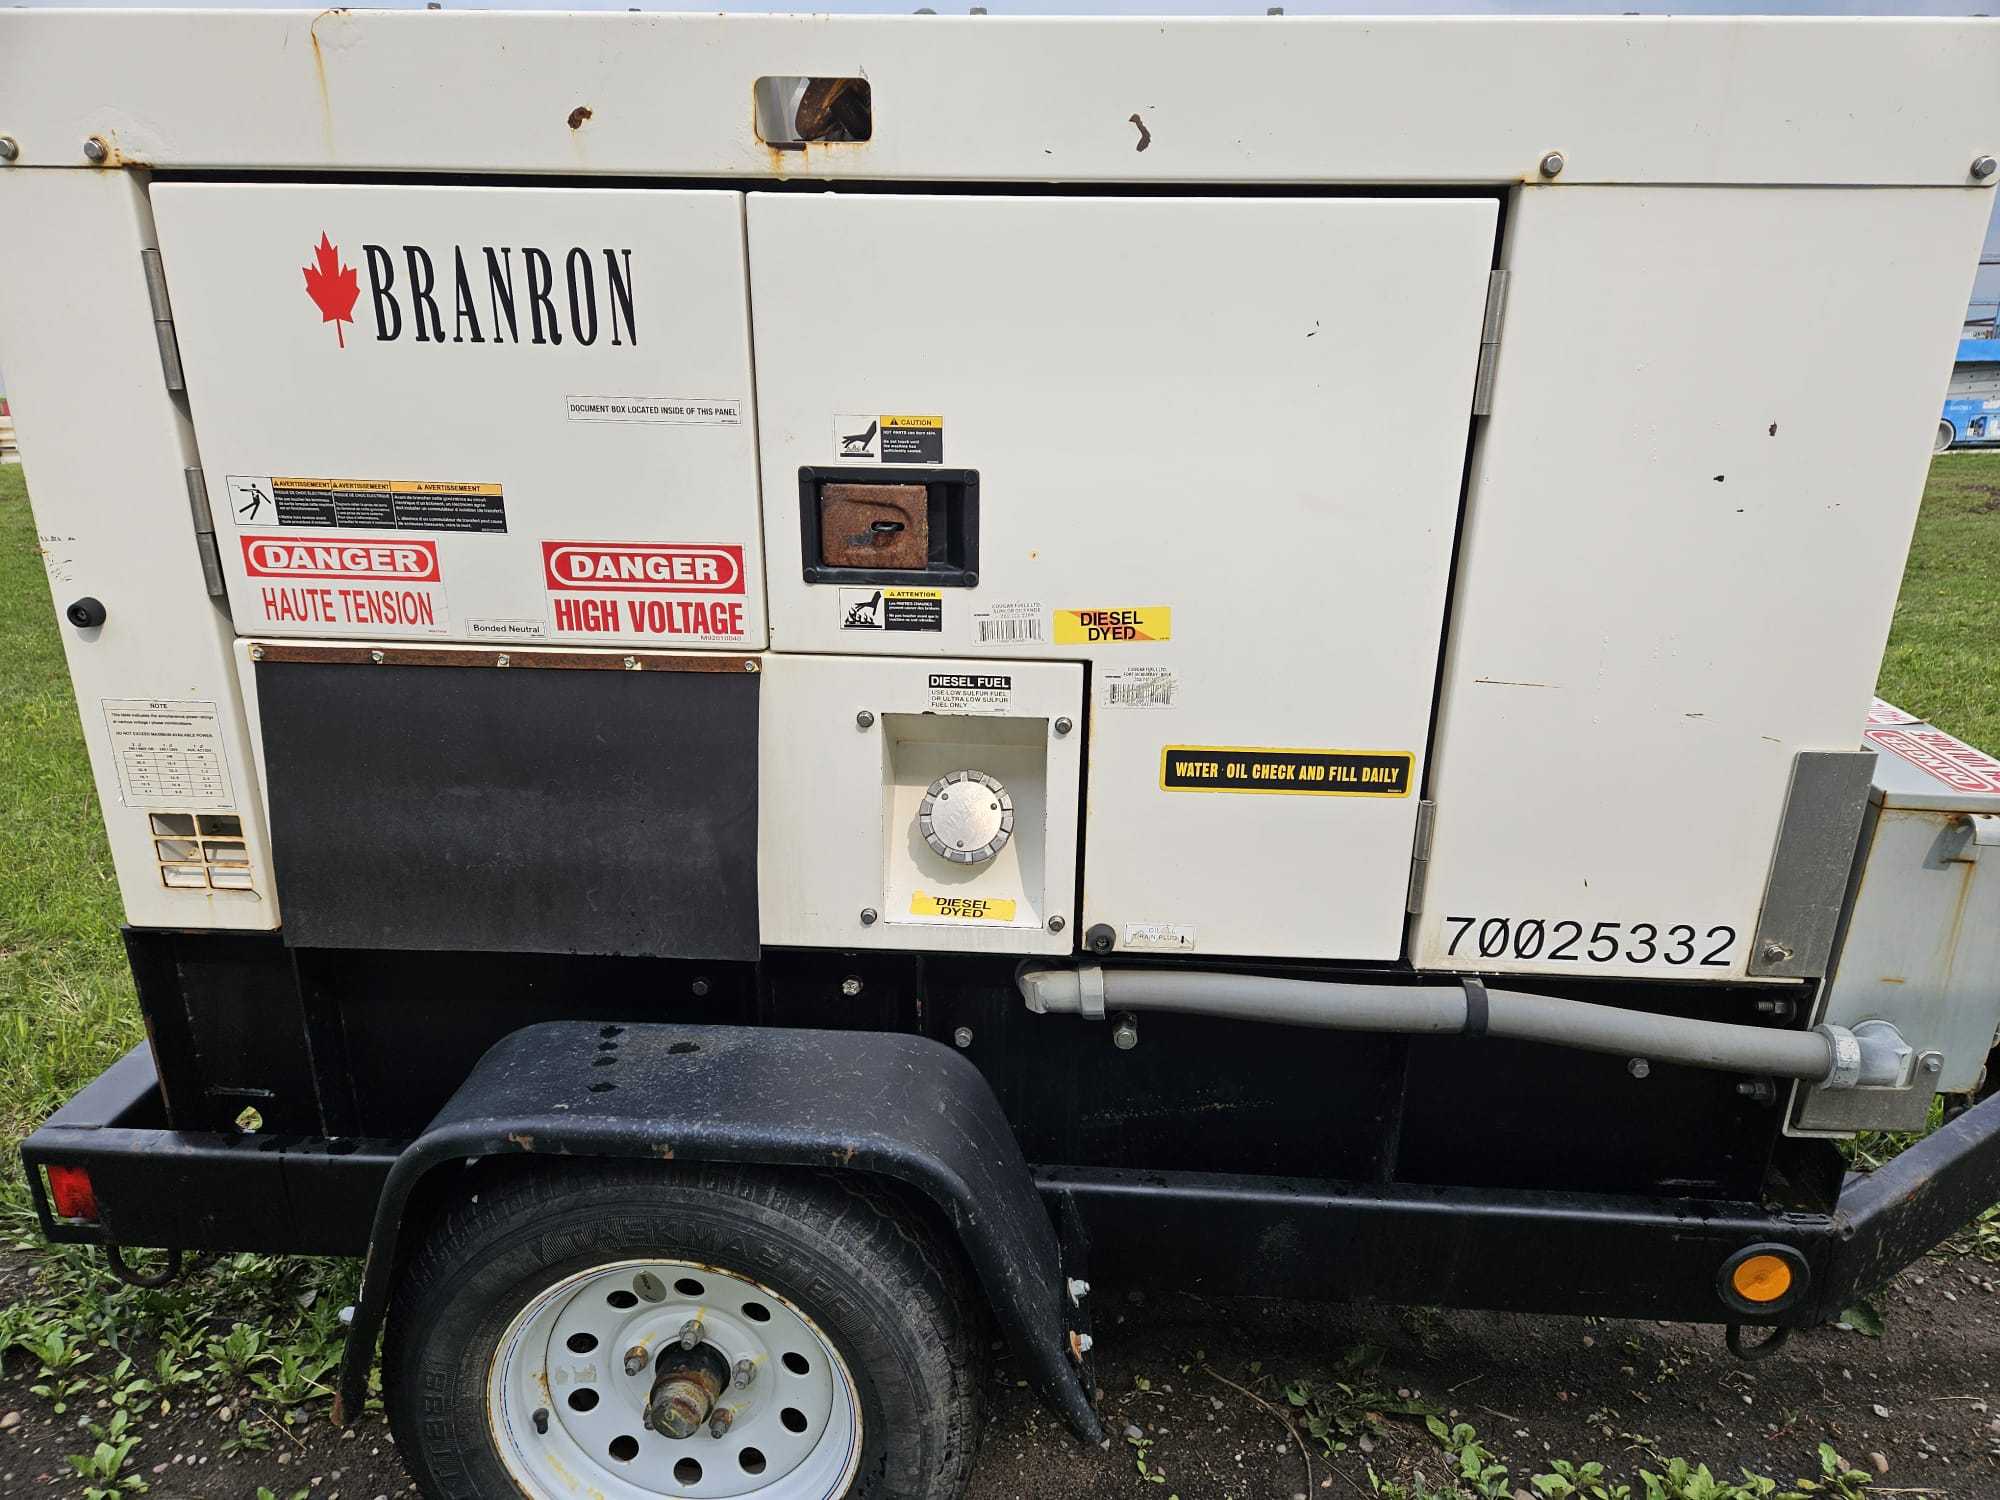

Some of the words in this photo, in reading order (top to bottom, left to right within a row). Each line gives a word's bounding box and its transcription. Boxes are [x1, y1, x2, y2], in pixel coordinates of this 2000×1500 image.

[362, 244, 637, 346] BRANRON
[570, 404, 609, 413] DOCUMENT
[611, 405, 626, 413] BOX
[627, 405, 659, 414] LOCATED
[660, 406, 684, 415] INSIDE
[686, 407, 695, 415] OF
[697, 407, 713, 416] THIS
[714, 408, 737, 417] PANEL
[263, 545, 422, 572] DANGER
[569, 555, 719, 581] DANGER
[262, 587, 337, 623] HAUTE
[338, 589, 435, 625] TENSION
[553, 598, 621, 632] HIGH
[628, 600, 744, 635] VOLTAGE
[1080, 610, 1144, 626] DIESEL
[473, 624, 507, 633] Bonded
[509, 625, 540, 633] Neutral
[1088, 626, 1136, 641] DYED
[930, 675, 975, 687] DIESEL
[977, 677, 1009, 688] FUEL
[1175, 761, 1219, 778] WATER
[1226, 762, 1249, 779] OIL
[1252, 763, 1295, 780] CHECK
[1298, 765, 1325, 781] AND
[1329, 765, 1357, 782] FILL
[1361, 767, 1400, 783] DAILY
[935, 896, 992, 910] DIESEL
[940, 906, 984, 918] DYED
